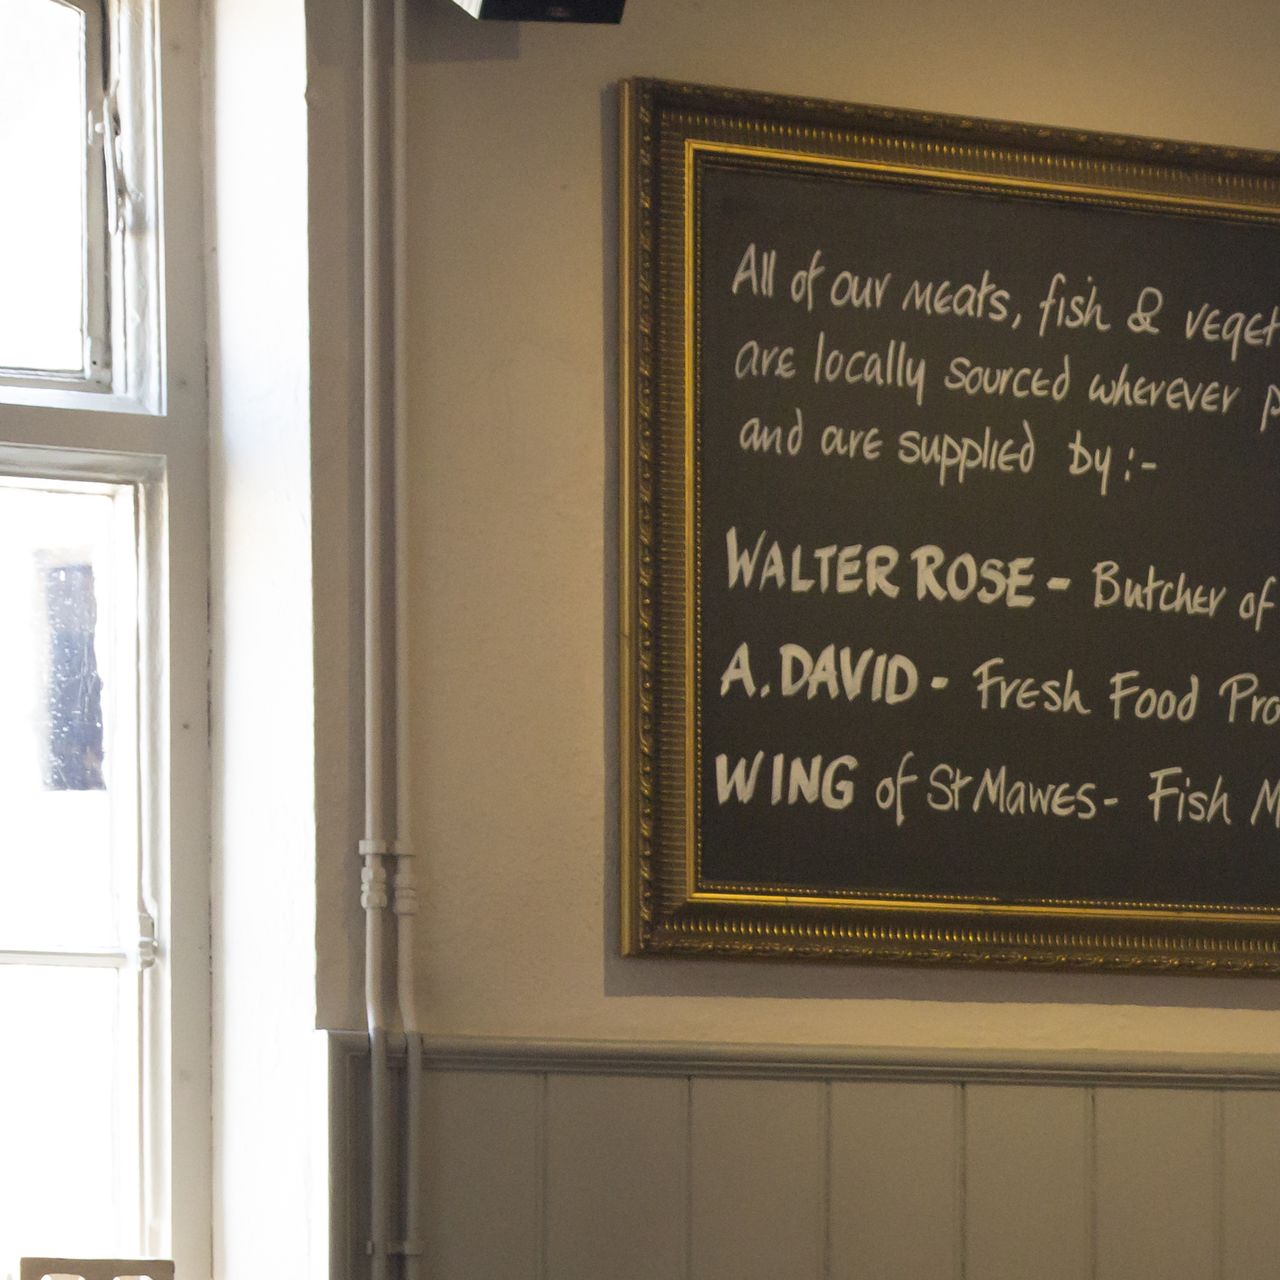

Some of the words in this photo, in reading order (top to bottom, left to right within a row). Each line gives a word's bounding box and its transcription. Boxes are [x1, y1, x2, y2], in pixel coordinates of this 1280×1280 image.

[730, 242, 777, 298] All
[789, 248, 826, 313] of
[829, 269, 893, 310] our
[900, 268, 1023, 330] meats,
[1037, 271, 1112, 338] fish
[1125, 285, 1164, 335] &
[733, 339, 797, 380] are
[813, 330, 927, 408] locally
[942, 353, 1072, 403] sourced
[1087, 362, 1240, 415] wherever
[738, 406, 804, 457] and
[819, 424, 884, 461] are
[896, 418, 1036, 488] supplied
[725, 525, 901, 600] WALTER
[909, 543, 1037, 609] ROSE
[1090, 559, 1228, 618] Butcher
[1237, 574, 1278, 633] of
[971, 656, 1093, 716] Fresh
[1108, 668, 1200, 724] Food
[714, 749, 859, 811] WING
[874, 750, 920, 828] of
[1146, 765, 1233, 826] Fish
